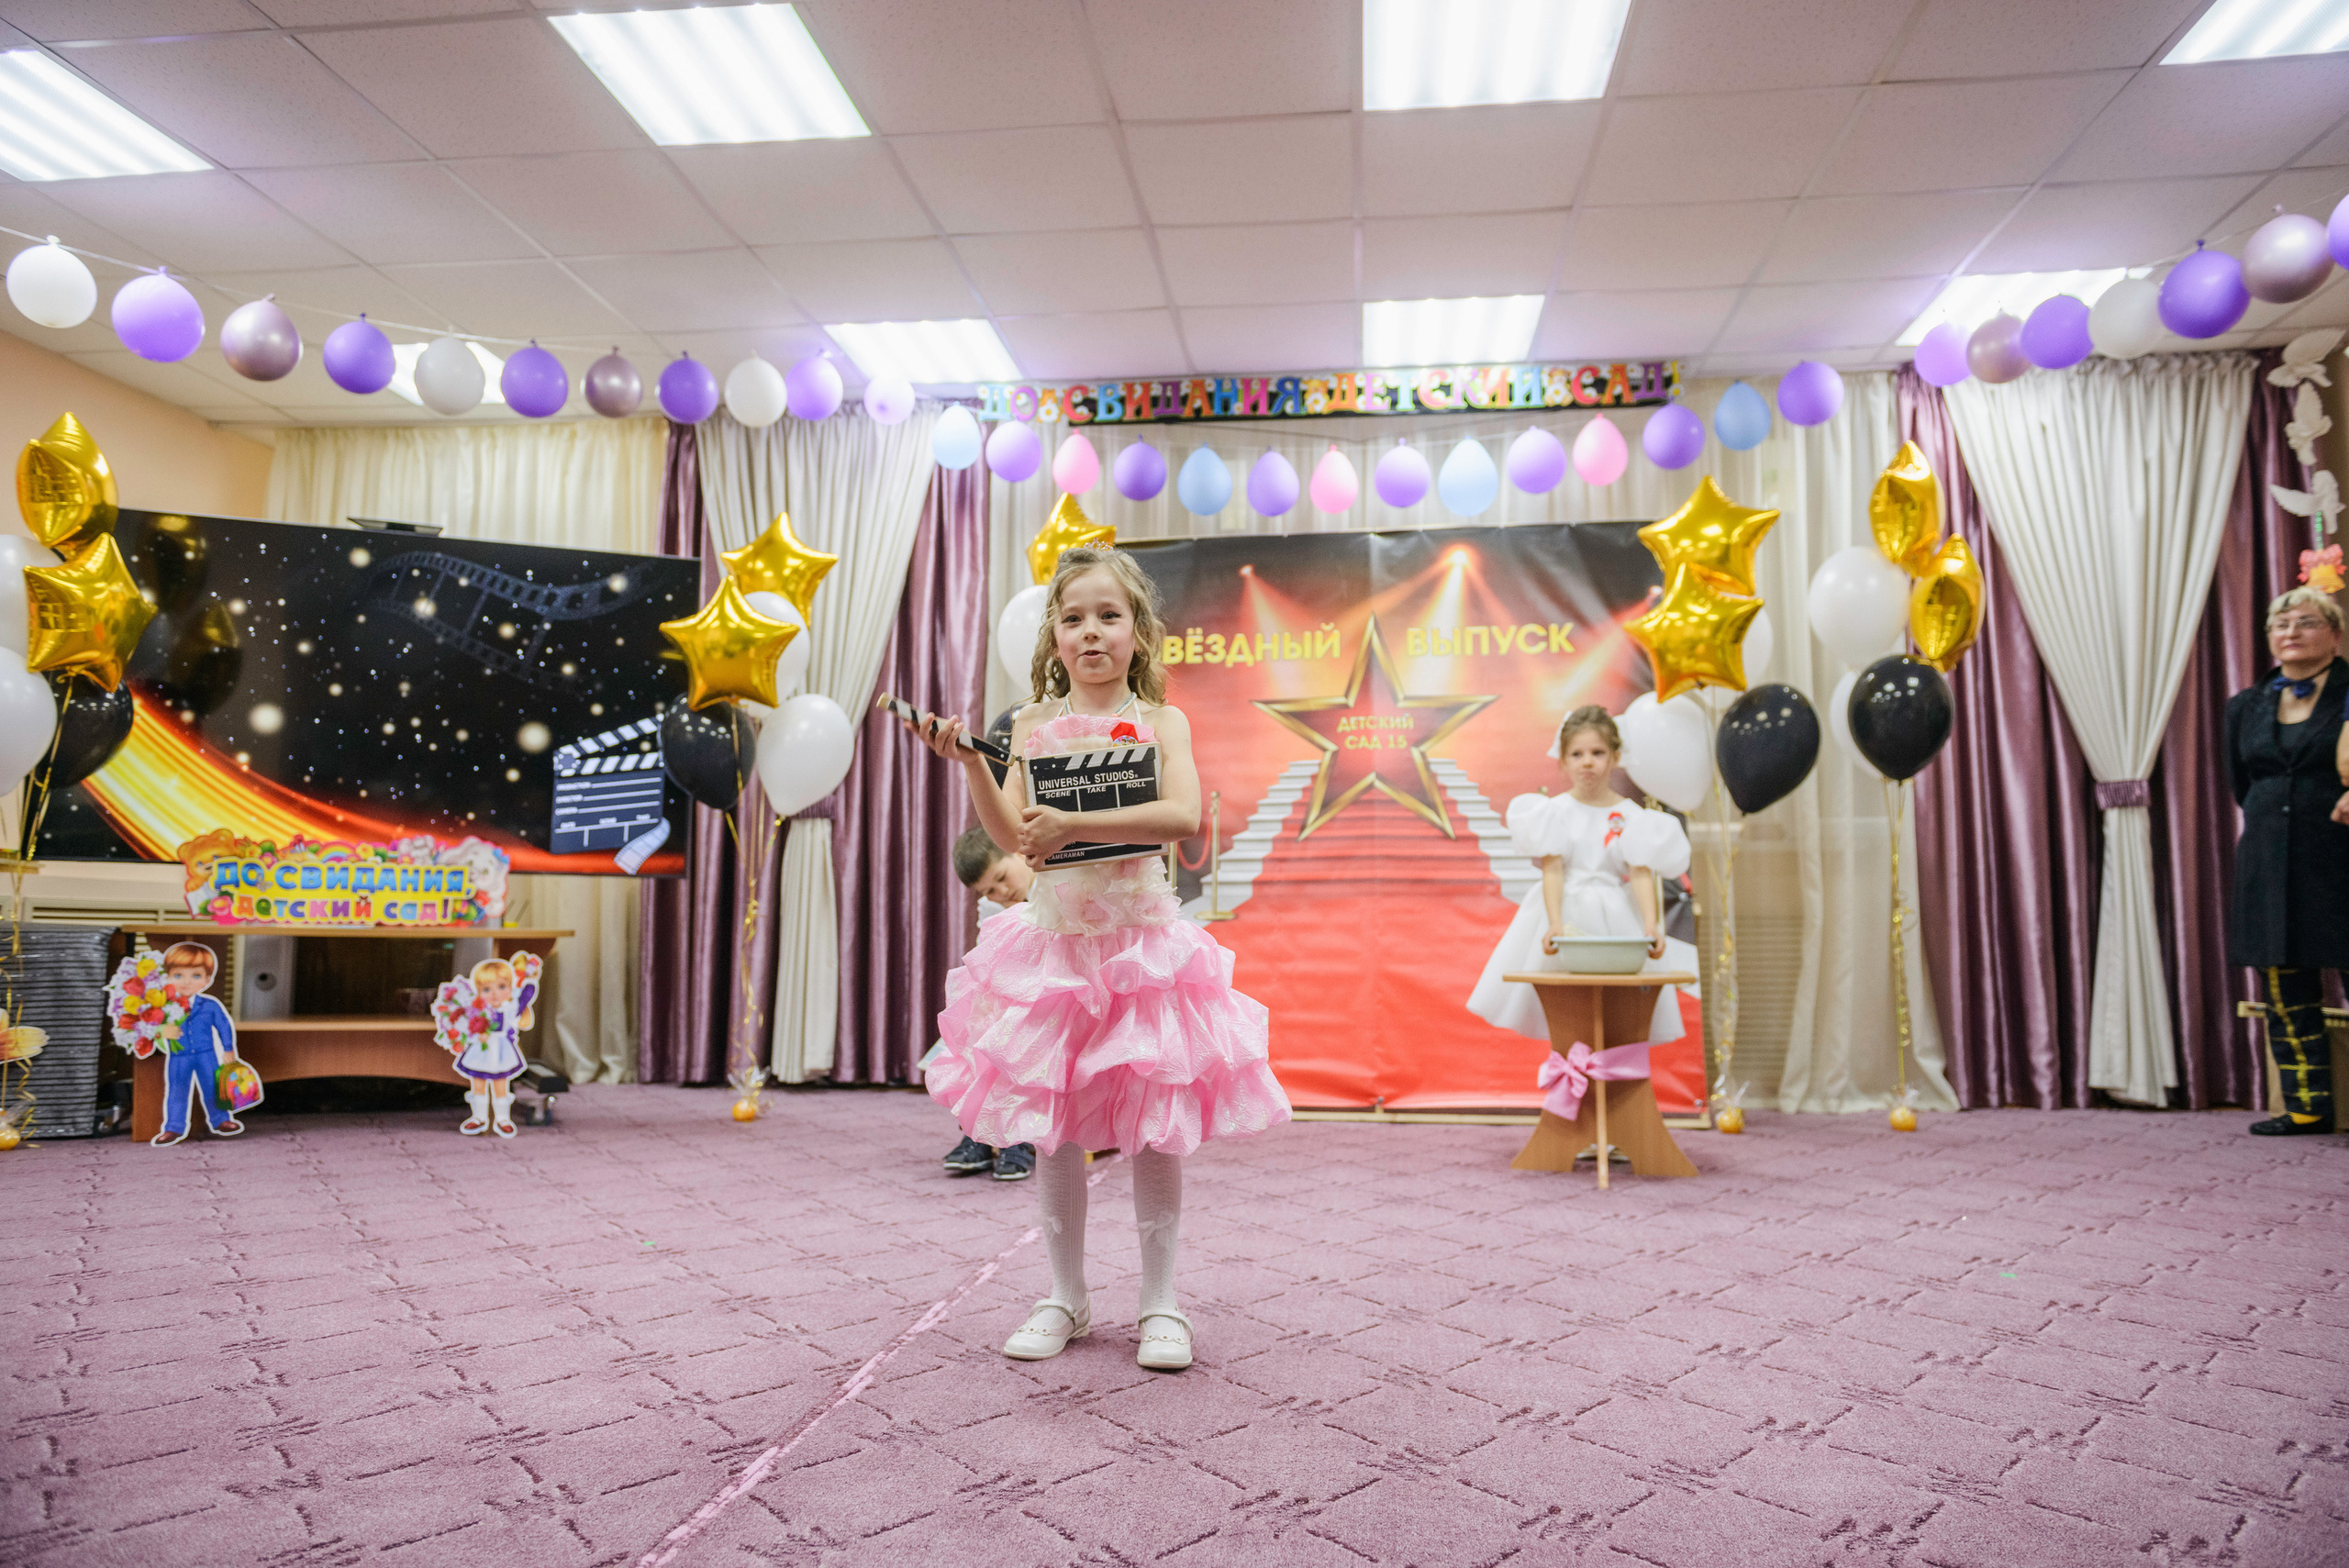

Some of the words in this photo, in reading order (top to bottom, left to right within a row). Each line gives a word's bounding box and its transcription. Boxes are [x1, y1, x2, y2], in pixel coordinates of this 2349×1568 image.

[977, 383, 1038, 421] ДО
[1062, 375, 1304, 422] СВИДАНИЯ
[1327, 364, 1545, 411] ДЕТСКИЙ
[1571, 361, 1685, 404] САД!
[1162, 622, 1341, 668] ВЁЗДНЫЙ
[1406, 622, 1575, 657] ВЫПУСК
[1337, 713, 1414, 733] ДЕТСКИЙ
[1344, 735, 1383, 751] САД
[1388, 735, 1408, 750] 15
[1038, 775, 1092, 790] UNIVERSAL
[1045, 790, 1072, 799] SCENE
[1087, 785, 1107, 794] TAKE
[1126, 781, 1146, 789] ROLL
[214, 862, 265, 890] ДО
[274, 864, 473, 896] СВИДАНИЯ,
